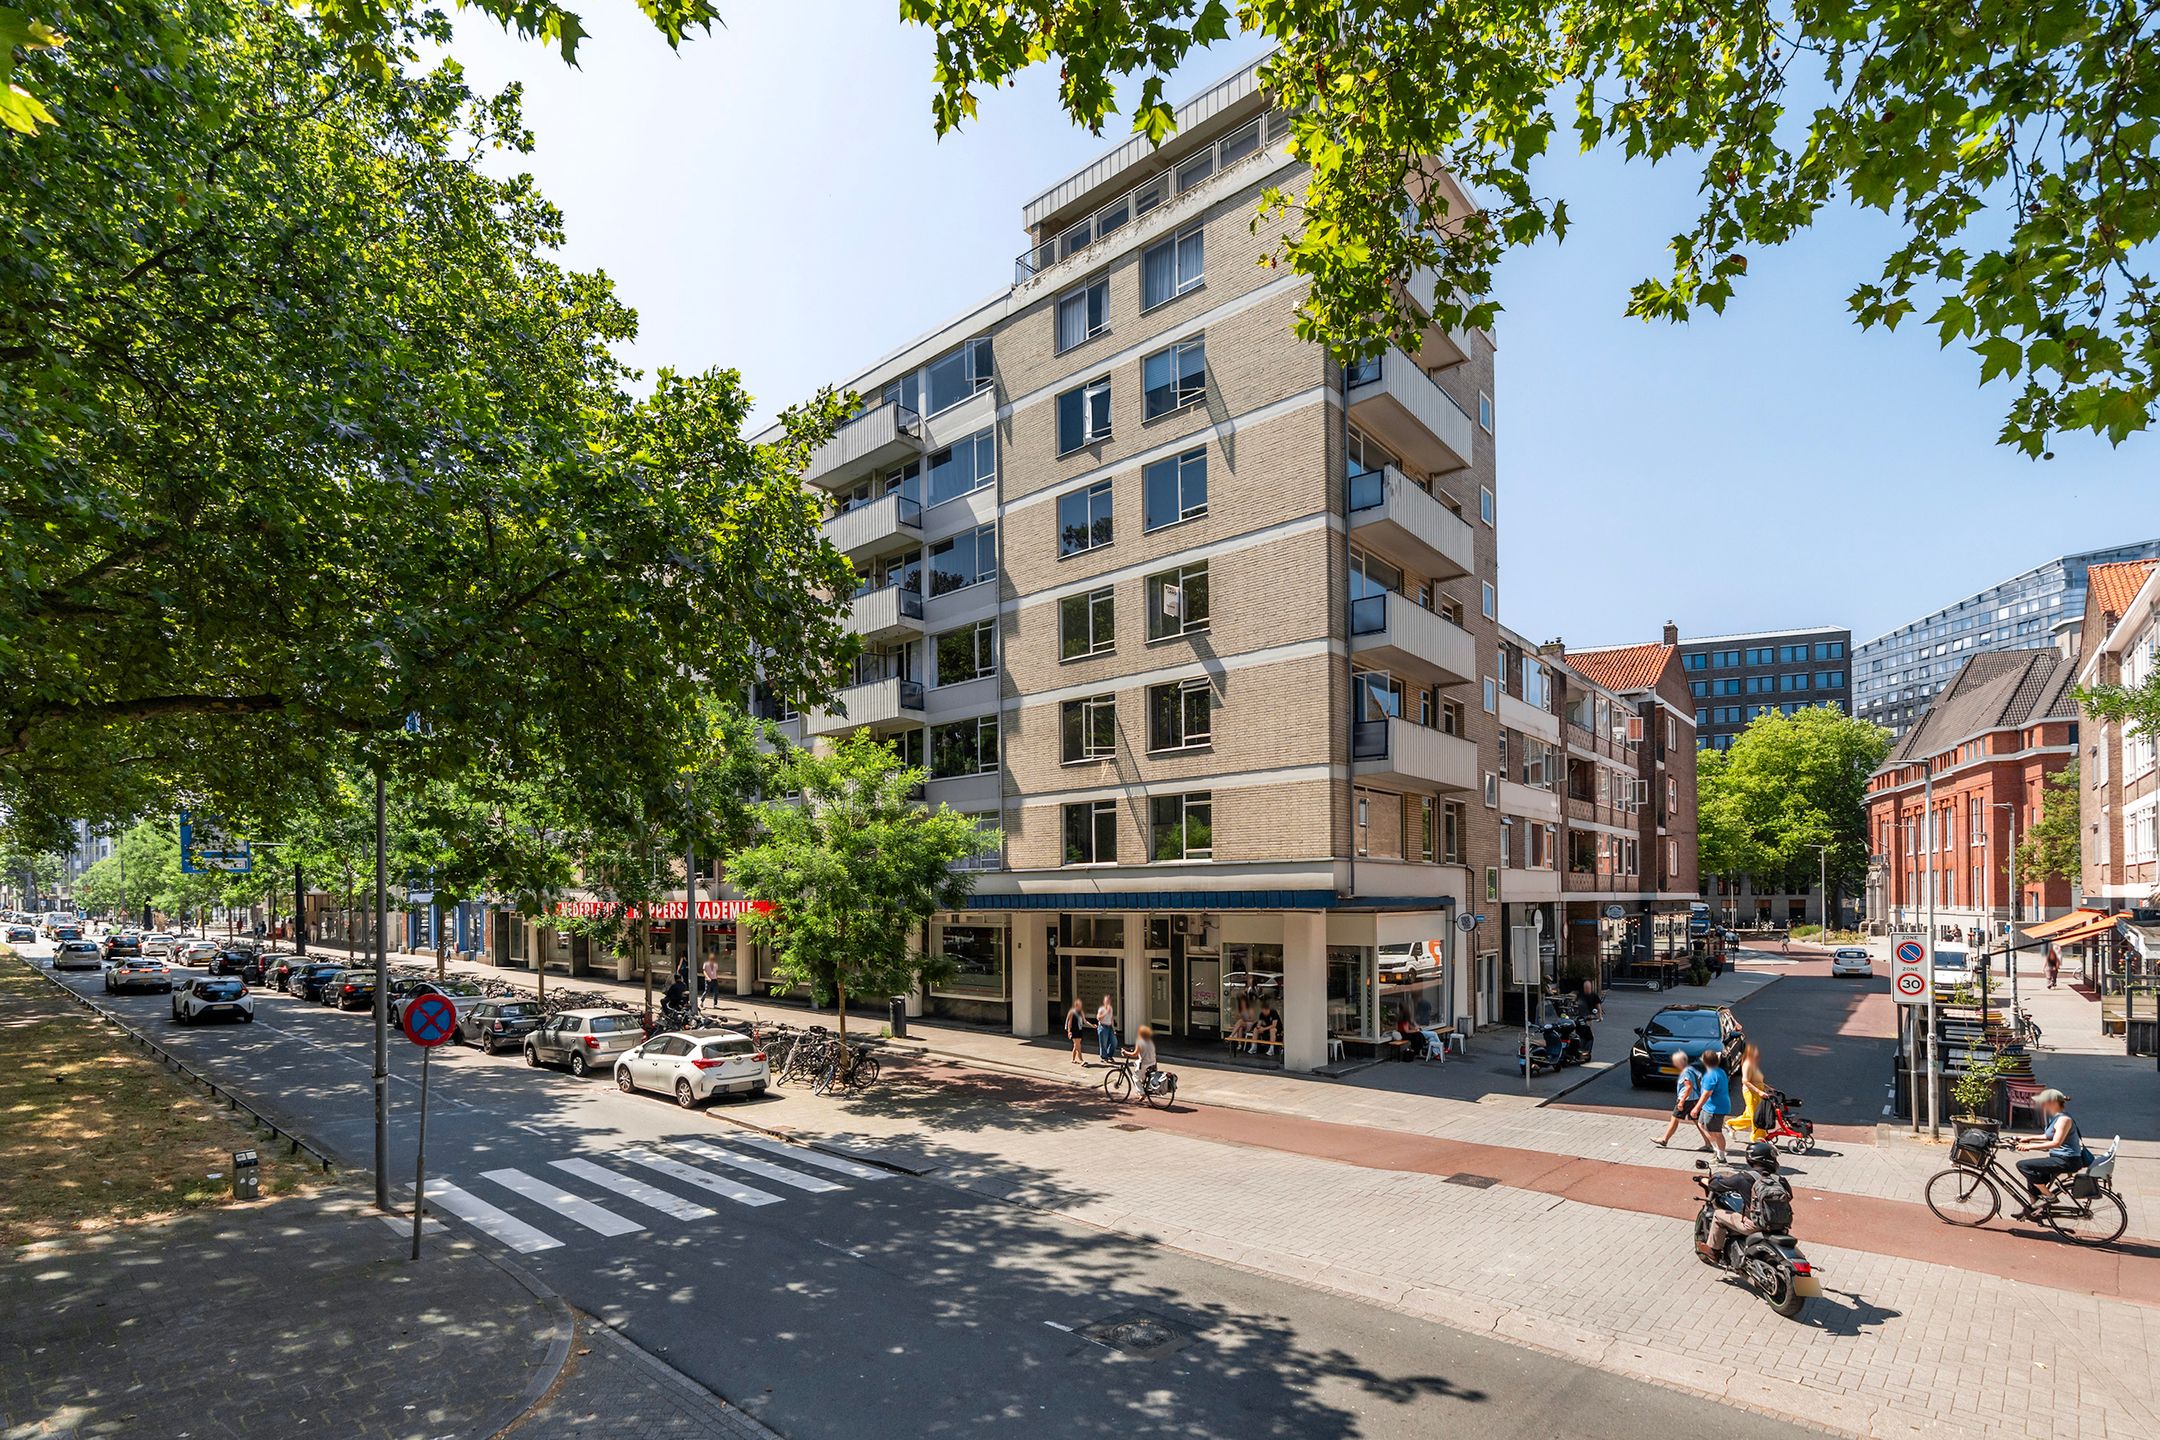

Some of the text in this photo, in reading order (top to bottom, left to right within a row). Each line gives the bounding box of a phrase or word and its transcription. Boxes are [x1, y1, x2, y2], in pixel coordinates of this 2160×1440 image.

[561, 902, 754, 919] NEDERLAND KPPERSKADEMIE
[1902, 979, 1921, 989] 30
